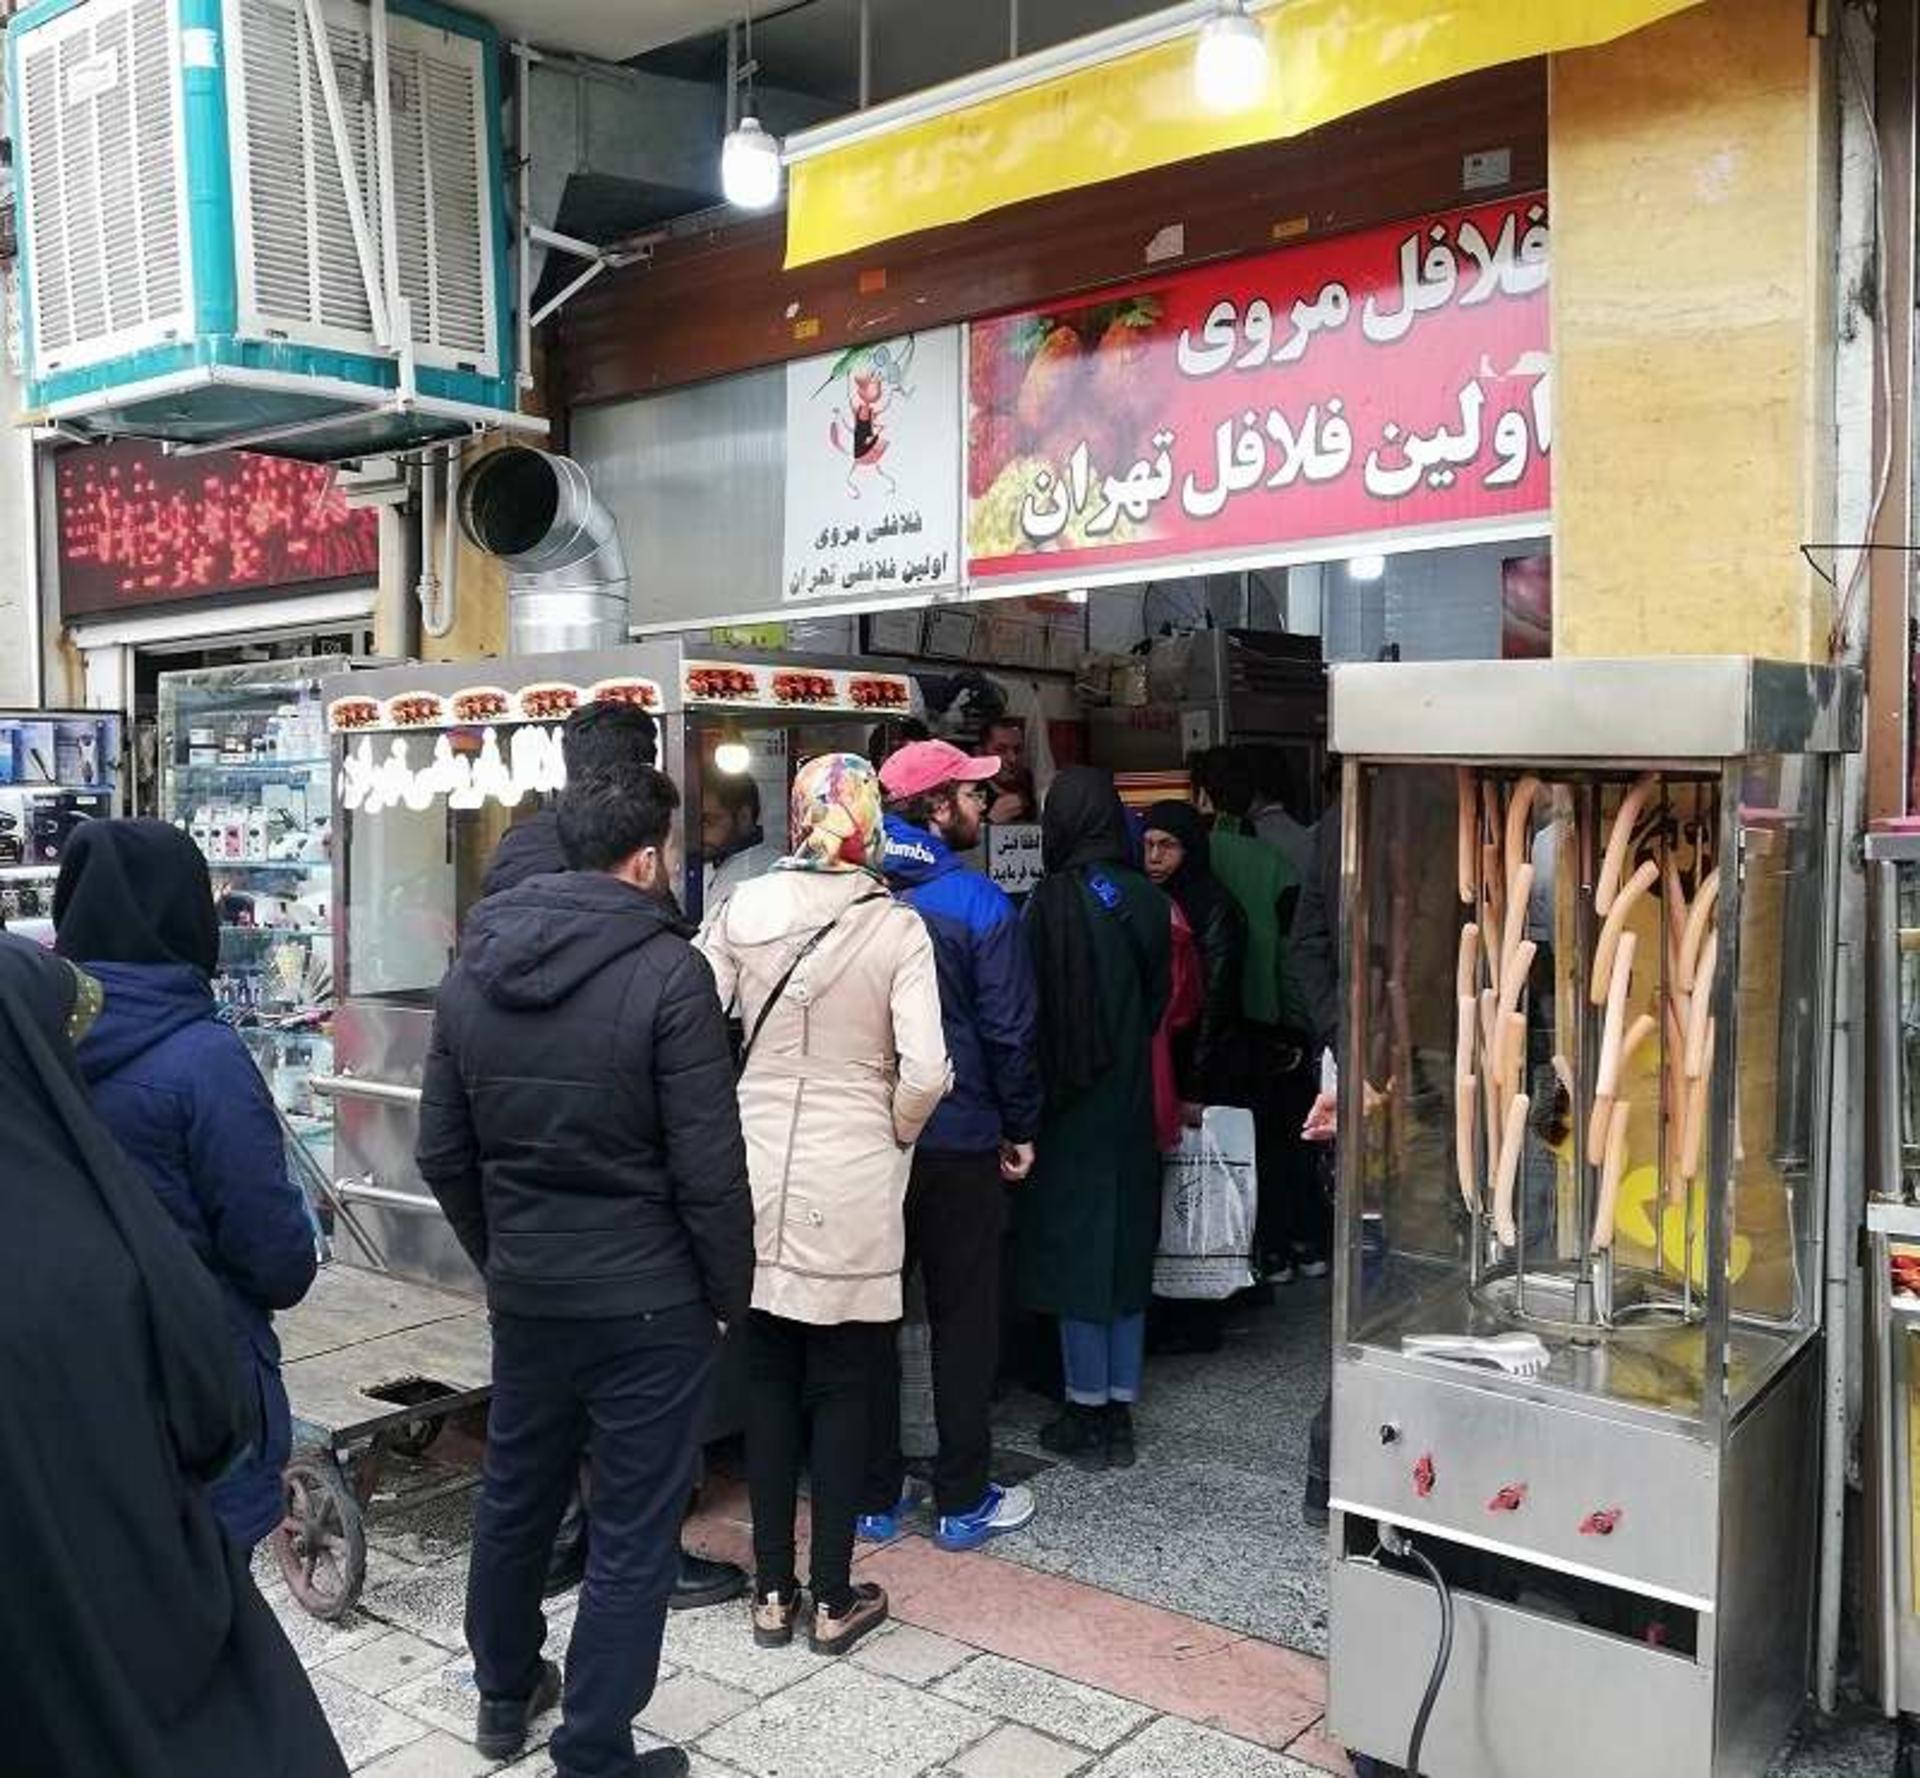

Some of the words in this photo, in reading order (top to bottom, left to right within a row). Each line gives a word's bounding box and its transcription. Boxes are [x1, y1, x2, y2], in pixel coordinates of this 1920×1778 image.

[1362, 205, 1550, 342] فلافل
[1177, 282, 1350, 374] مروی
[1021, 428, 1172, 538] تهران
[1183, 398, 1353, 517] فلافل
[789, 564, 835, 595] تهران
[902, 551, 948, 583] اولین
